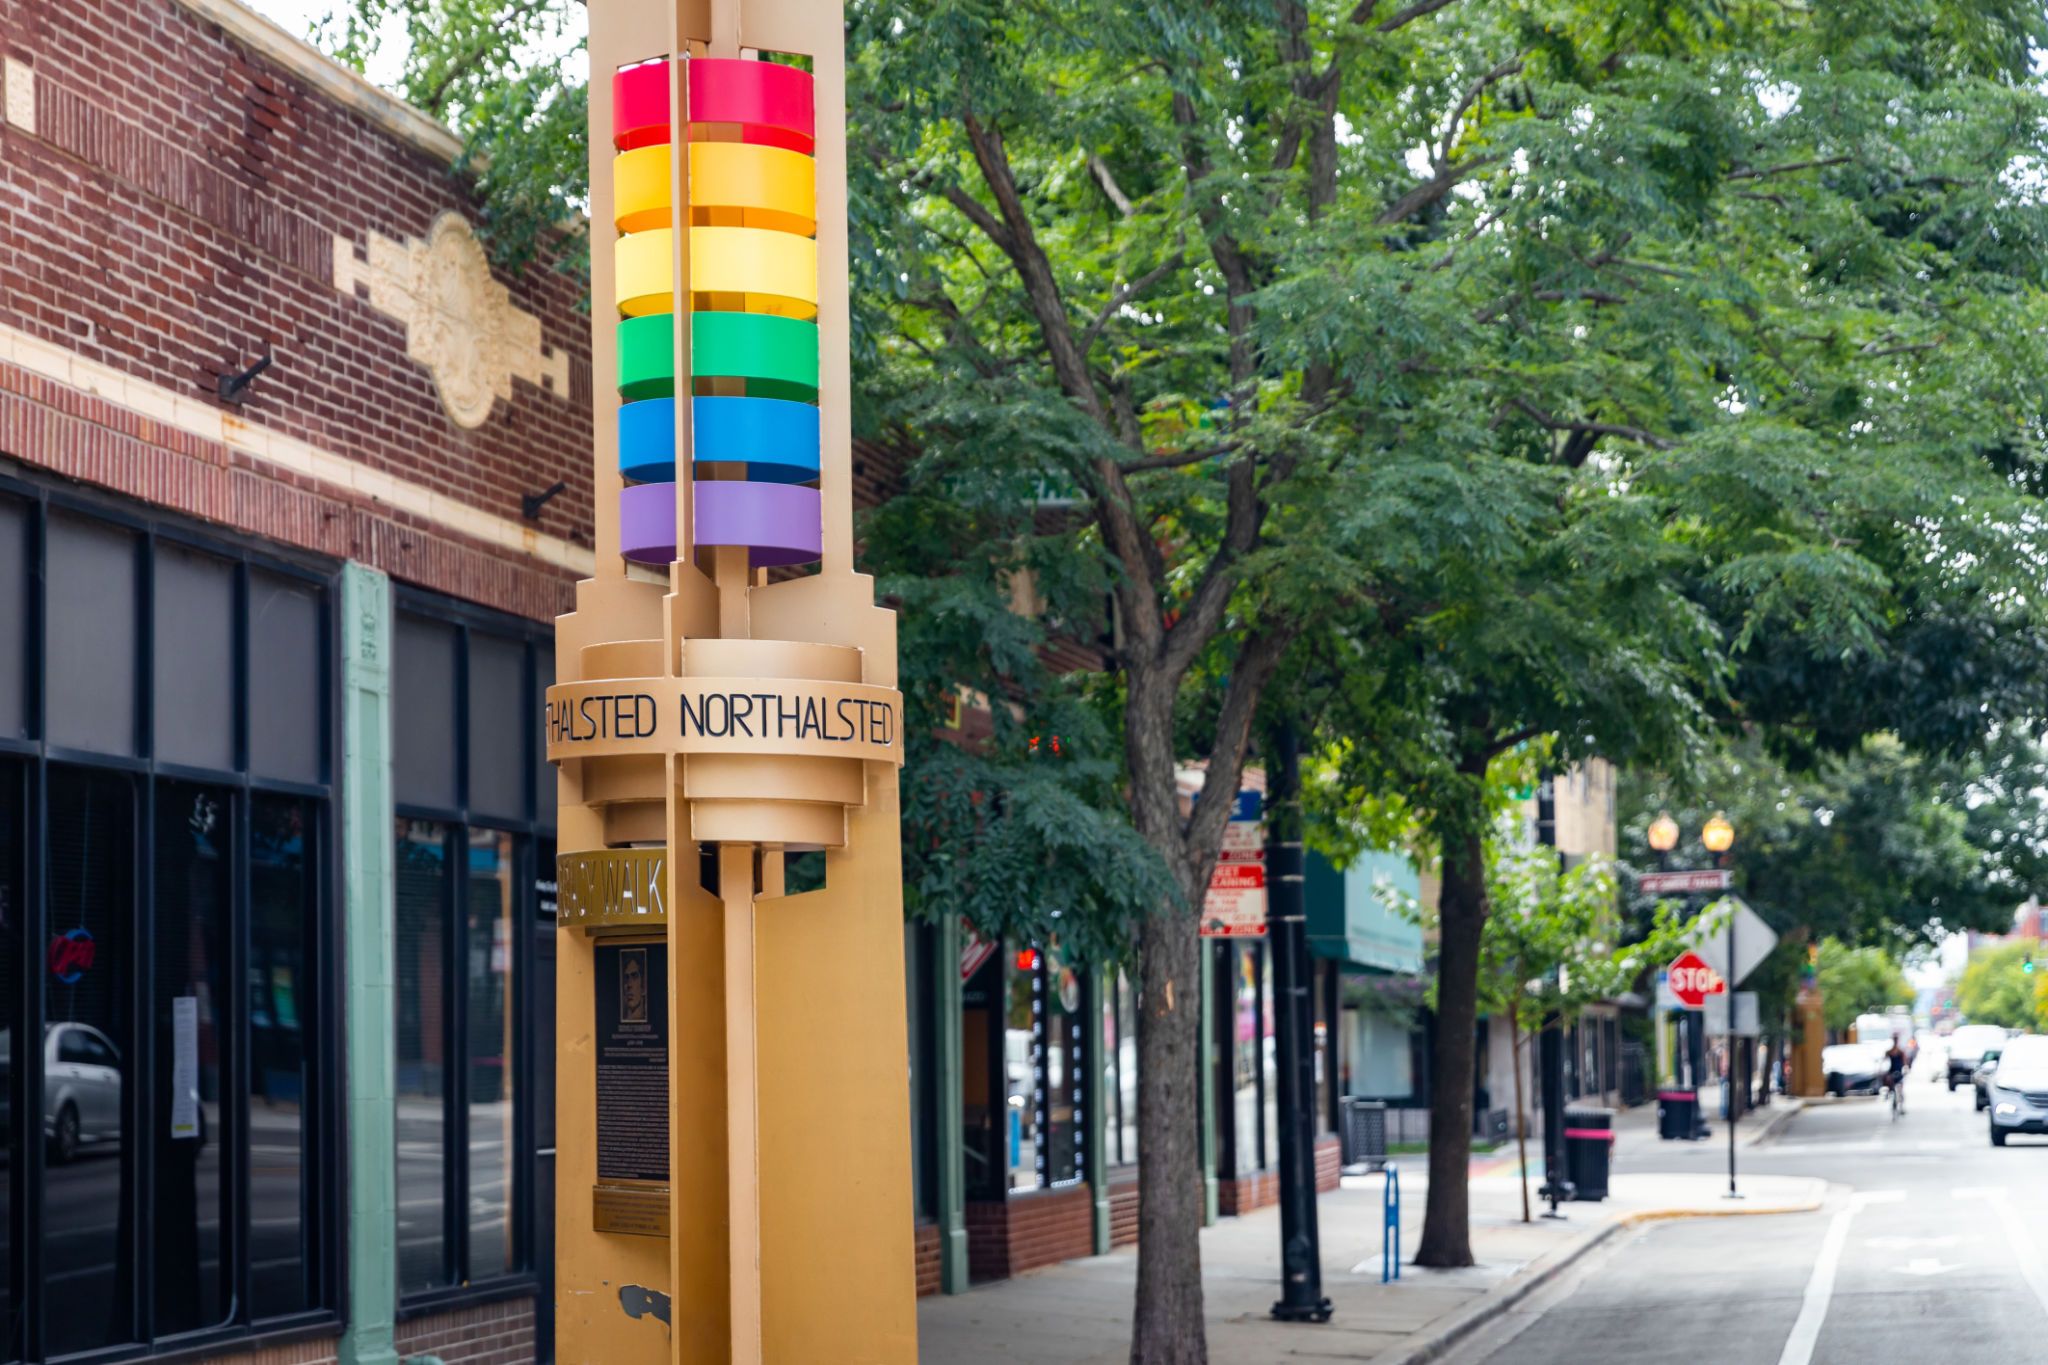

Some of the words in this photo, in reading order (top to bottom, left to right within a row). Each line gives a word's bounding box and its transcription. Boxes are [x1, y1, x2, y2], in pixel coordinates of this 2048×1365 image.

[681, 693, 893, 747] NORTHALSTED
[601, 860, 664, 915] WALK
[1671, 968, 1716, 992] STOP
